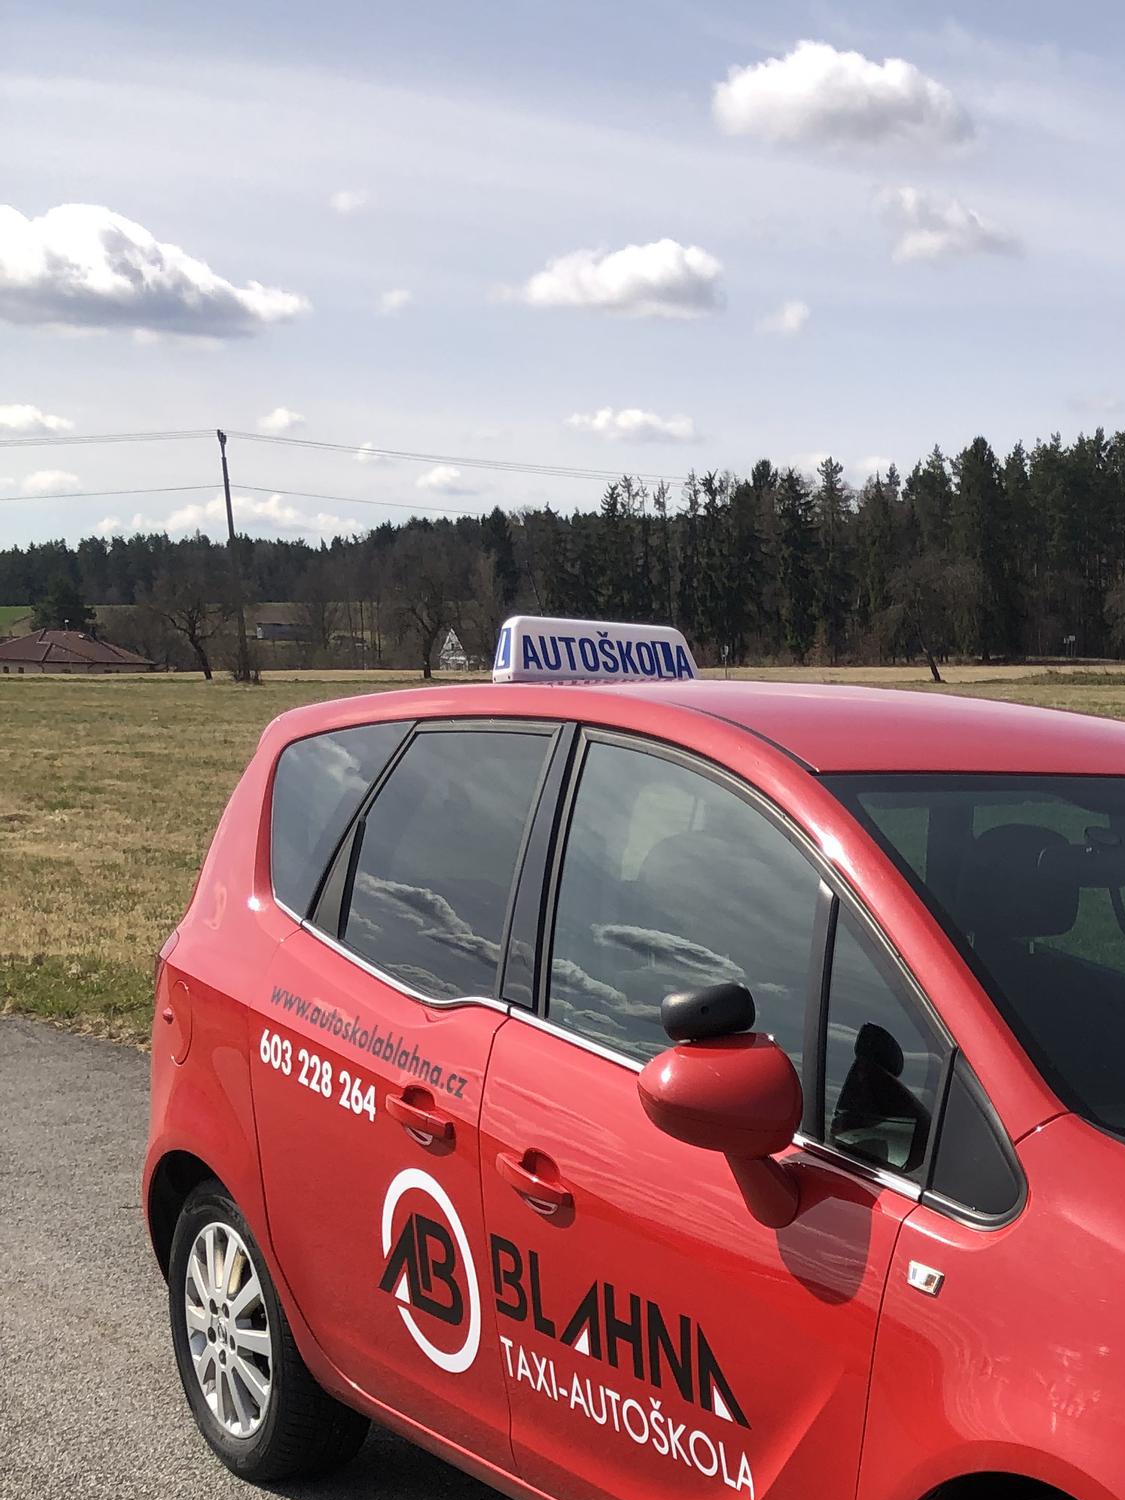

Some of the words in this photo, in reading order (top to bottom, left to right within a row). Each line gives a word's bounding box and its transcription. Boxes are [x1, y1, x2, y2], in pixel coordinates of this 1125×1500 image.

[497, 629, 509, 668] L
[522, 631, 694, 679] AUTOŠKOLA
[260, 1028, 293, 1076] 603
[298, 1048, 333, 1098] 228
[339, 1070, 377, 1122] 264
[271, 985, 468, 1098] www.autoskolablahna.cz
[377, 1213, 464, 1326] AB
[490, 1233, 752, 1430] BLAHNA
